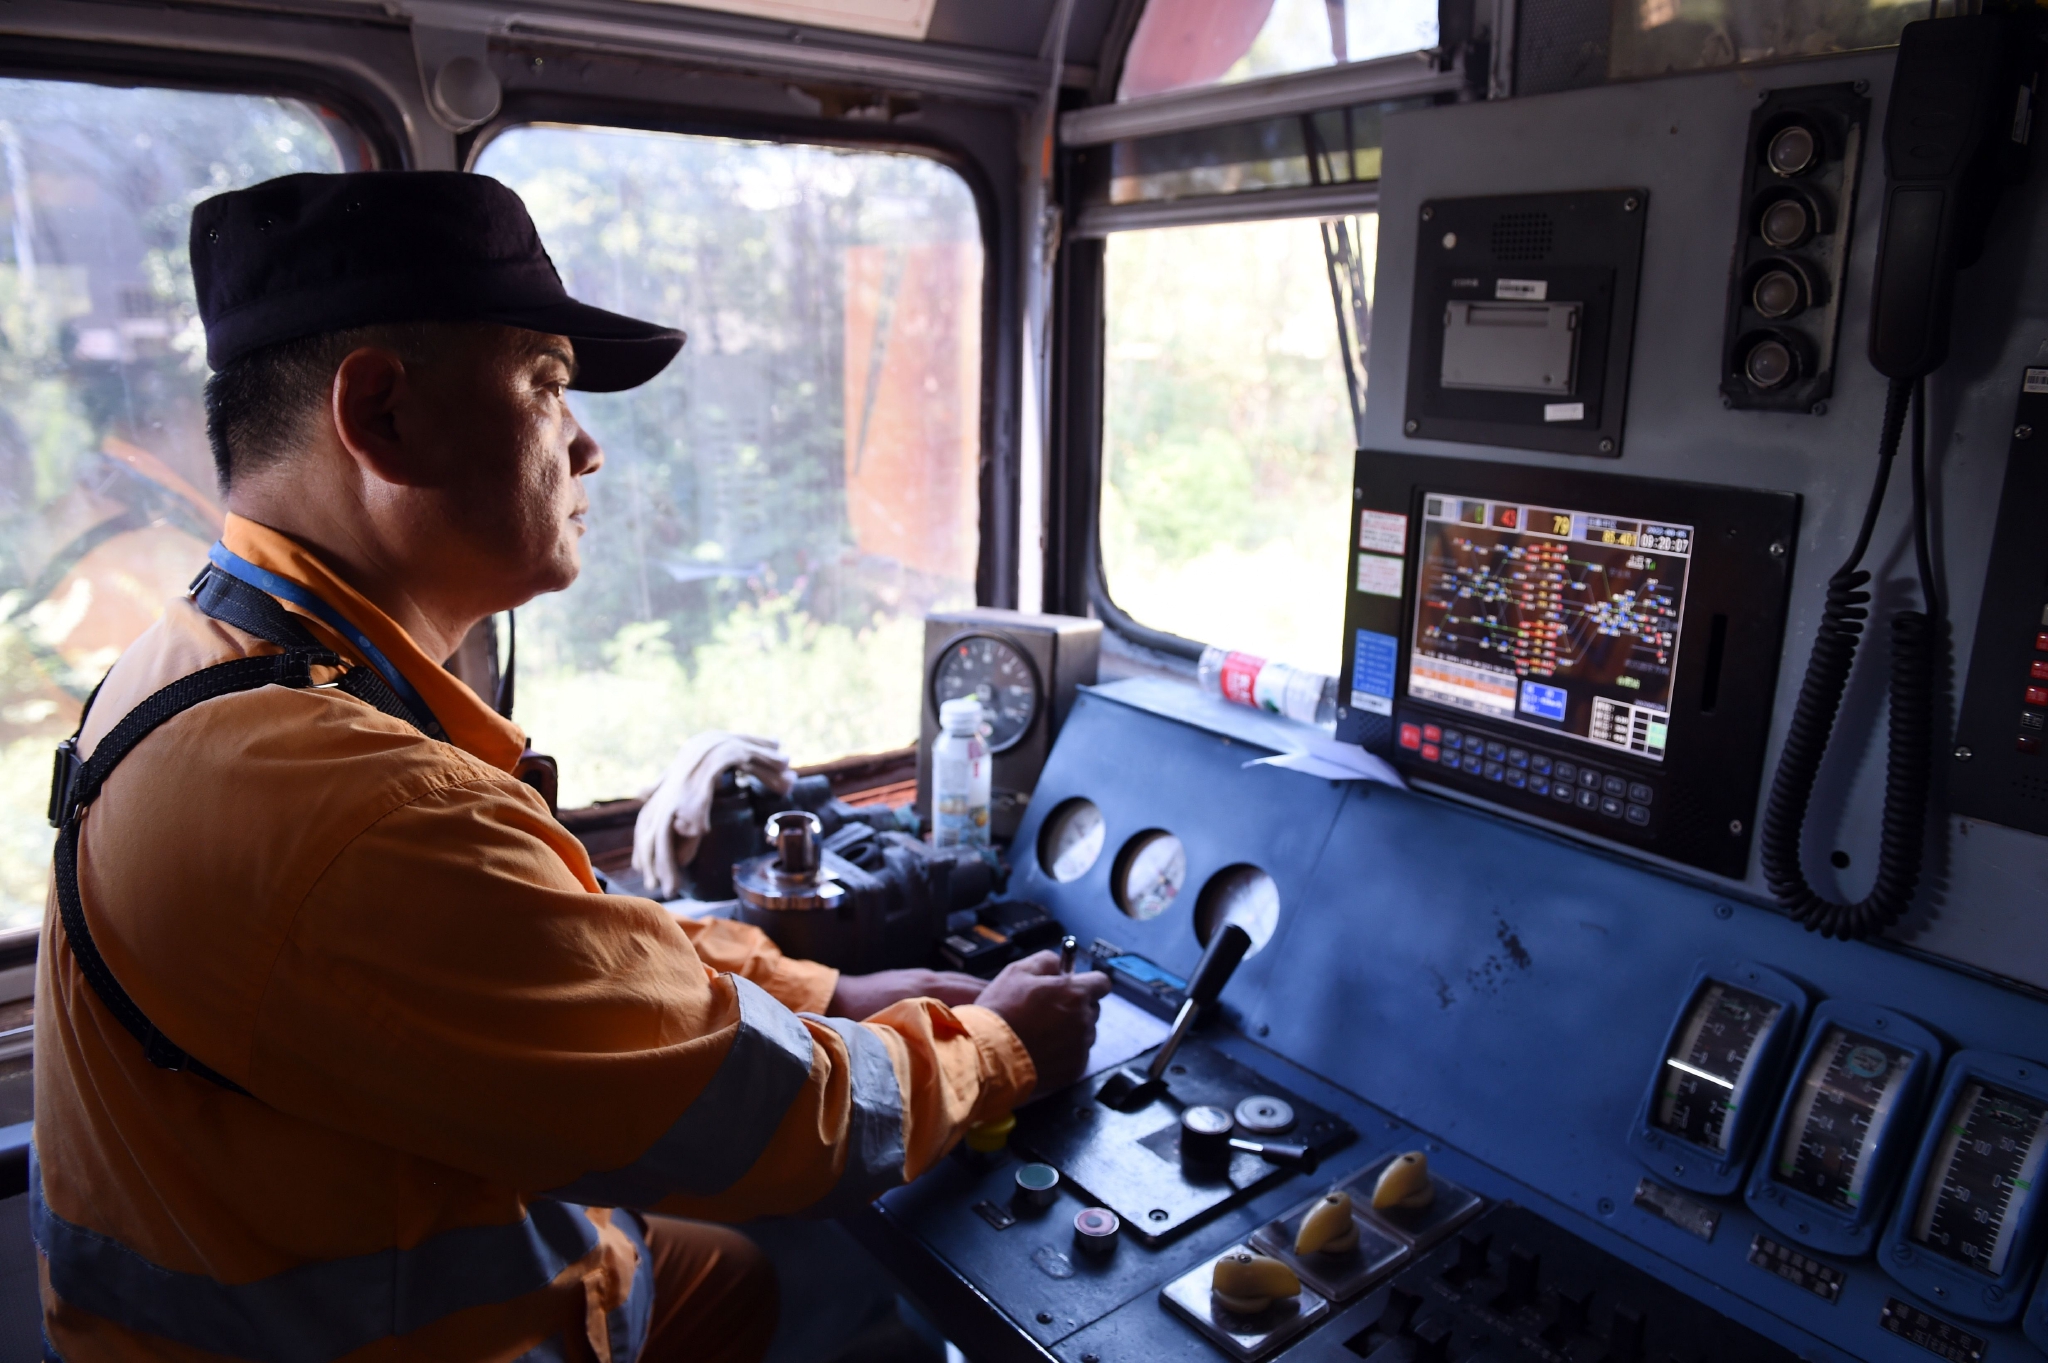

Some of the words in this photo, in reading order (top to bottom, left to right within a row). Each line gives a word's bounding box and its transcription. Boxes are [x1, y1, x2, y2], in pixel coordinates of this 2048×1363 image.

[1553, 515, 1570, 536] 79
[1640, 533, 1689, 553] 09:20:07
[1973, 1139, 1993, 1156] 100
[2000, 1136, 2016, 1153] 50
[1992, 1174, 2003, 1188] 0
[1955, 1185, 1971, 1203] 50
[1973, 1207, 1989, 1224] 50
[1961, 1240, 1979, 1259] 100
